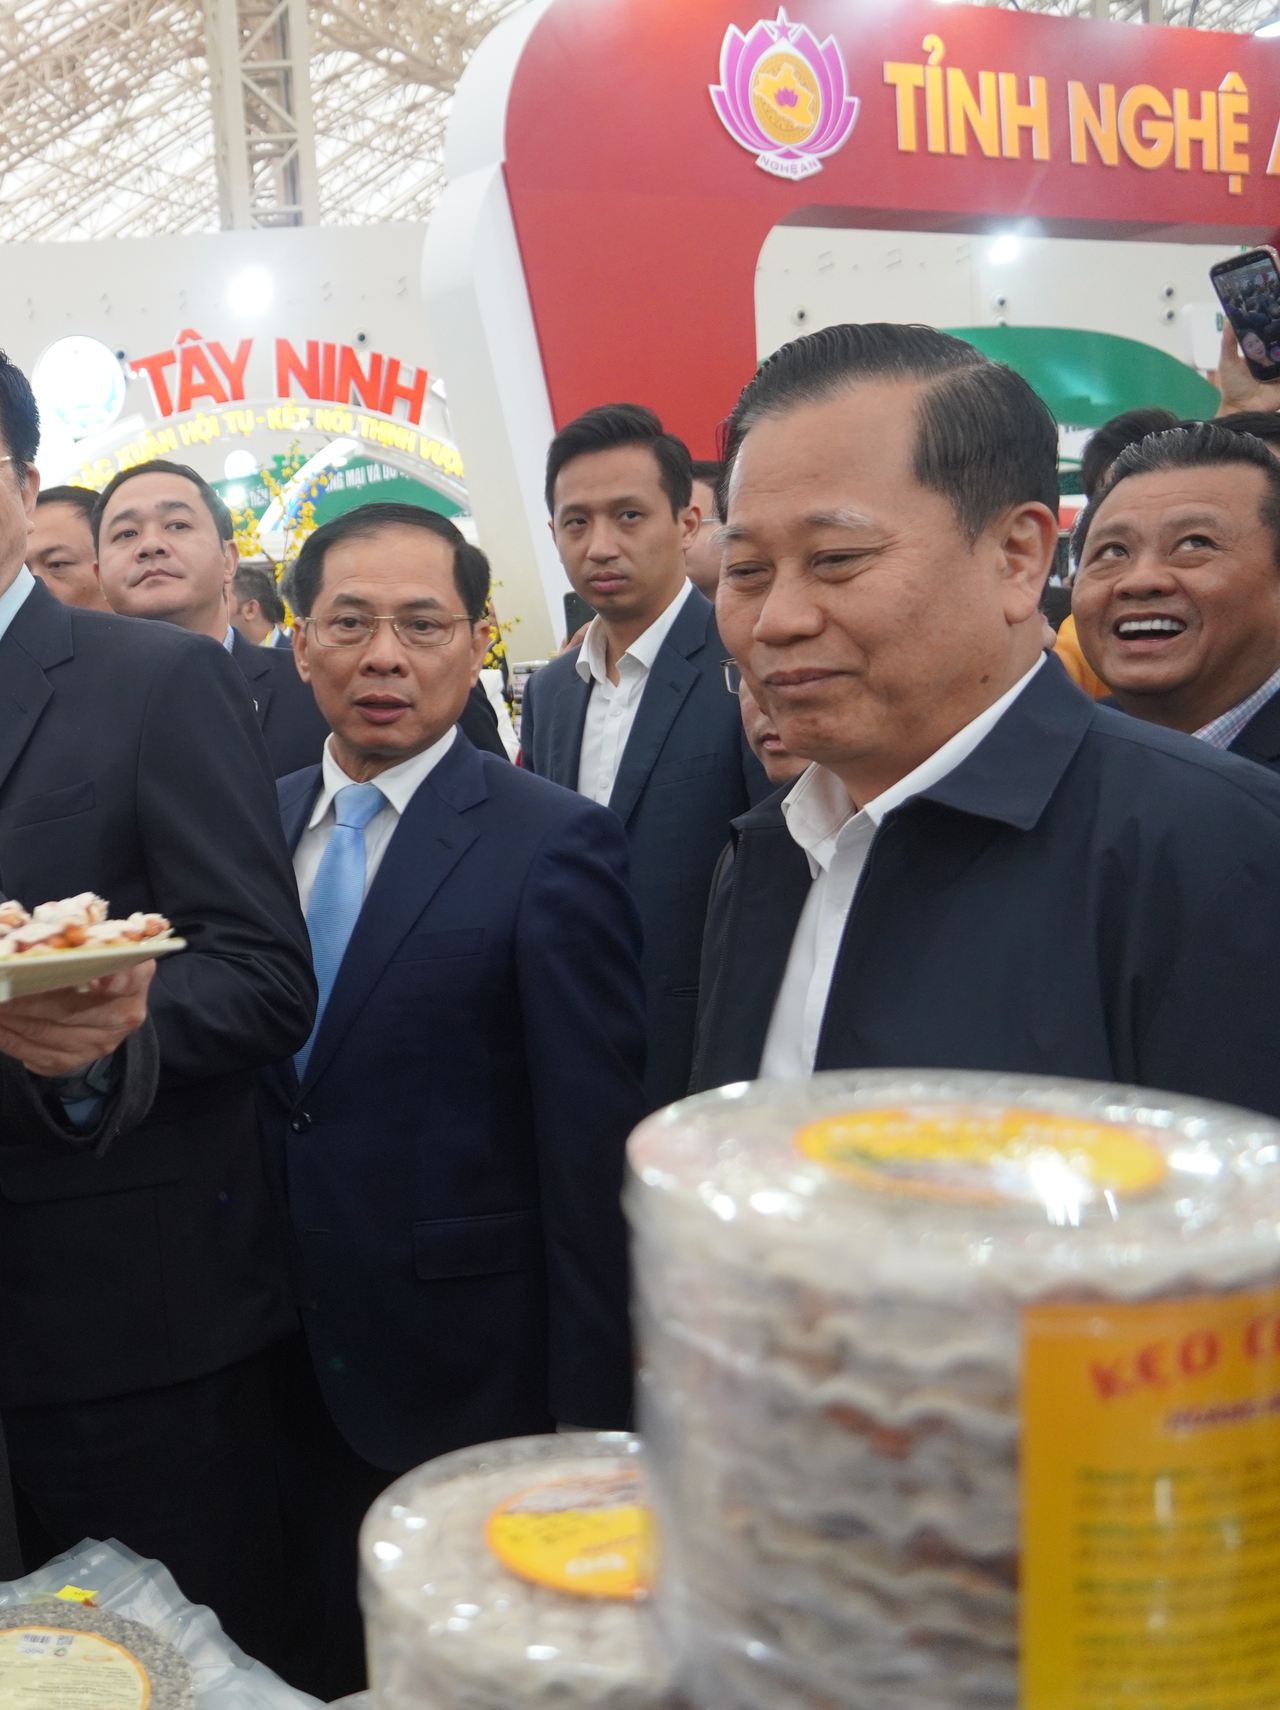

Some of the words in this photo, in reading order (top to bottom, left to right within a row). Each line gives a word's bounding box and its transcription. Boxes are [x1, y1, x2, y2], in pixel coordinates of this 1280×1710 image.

[884, 34, 1050, 161] TỈNH
[1068, 72, 1250, 195] NGHỆ
[801, 159, 818, 173] AN
[130, 328, 254, 417] TÂY
[275, 338, 428, 425] NINH
[115, 429, 179, 471] XUÂN
[179, 413, 220, 445] HỘI
[222, 409, 255, 436] TỤ
[268, 398, 310, 430] KẾT
[316, 403, 353, 434] NỐI
[357, 415, 417, 452] THỊNH
[346, 468, 364, 491] MẠI
[366, 461, 382, 482] VÀ
